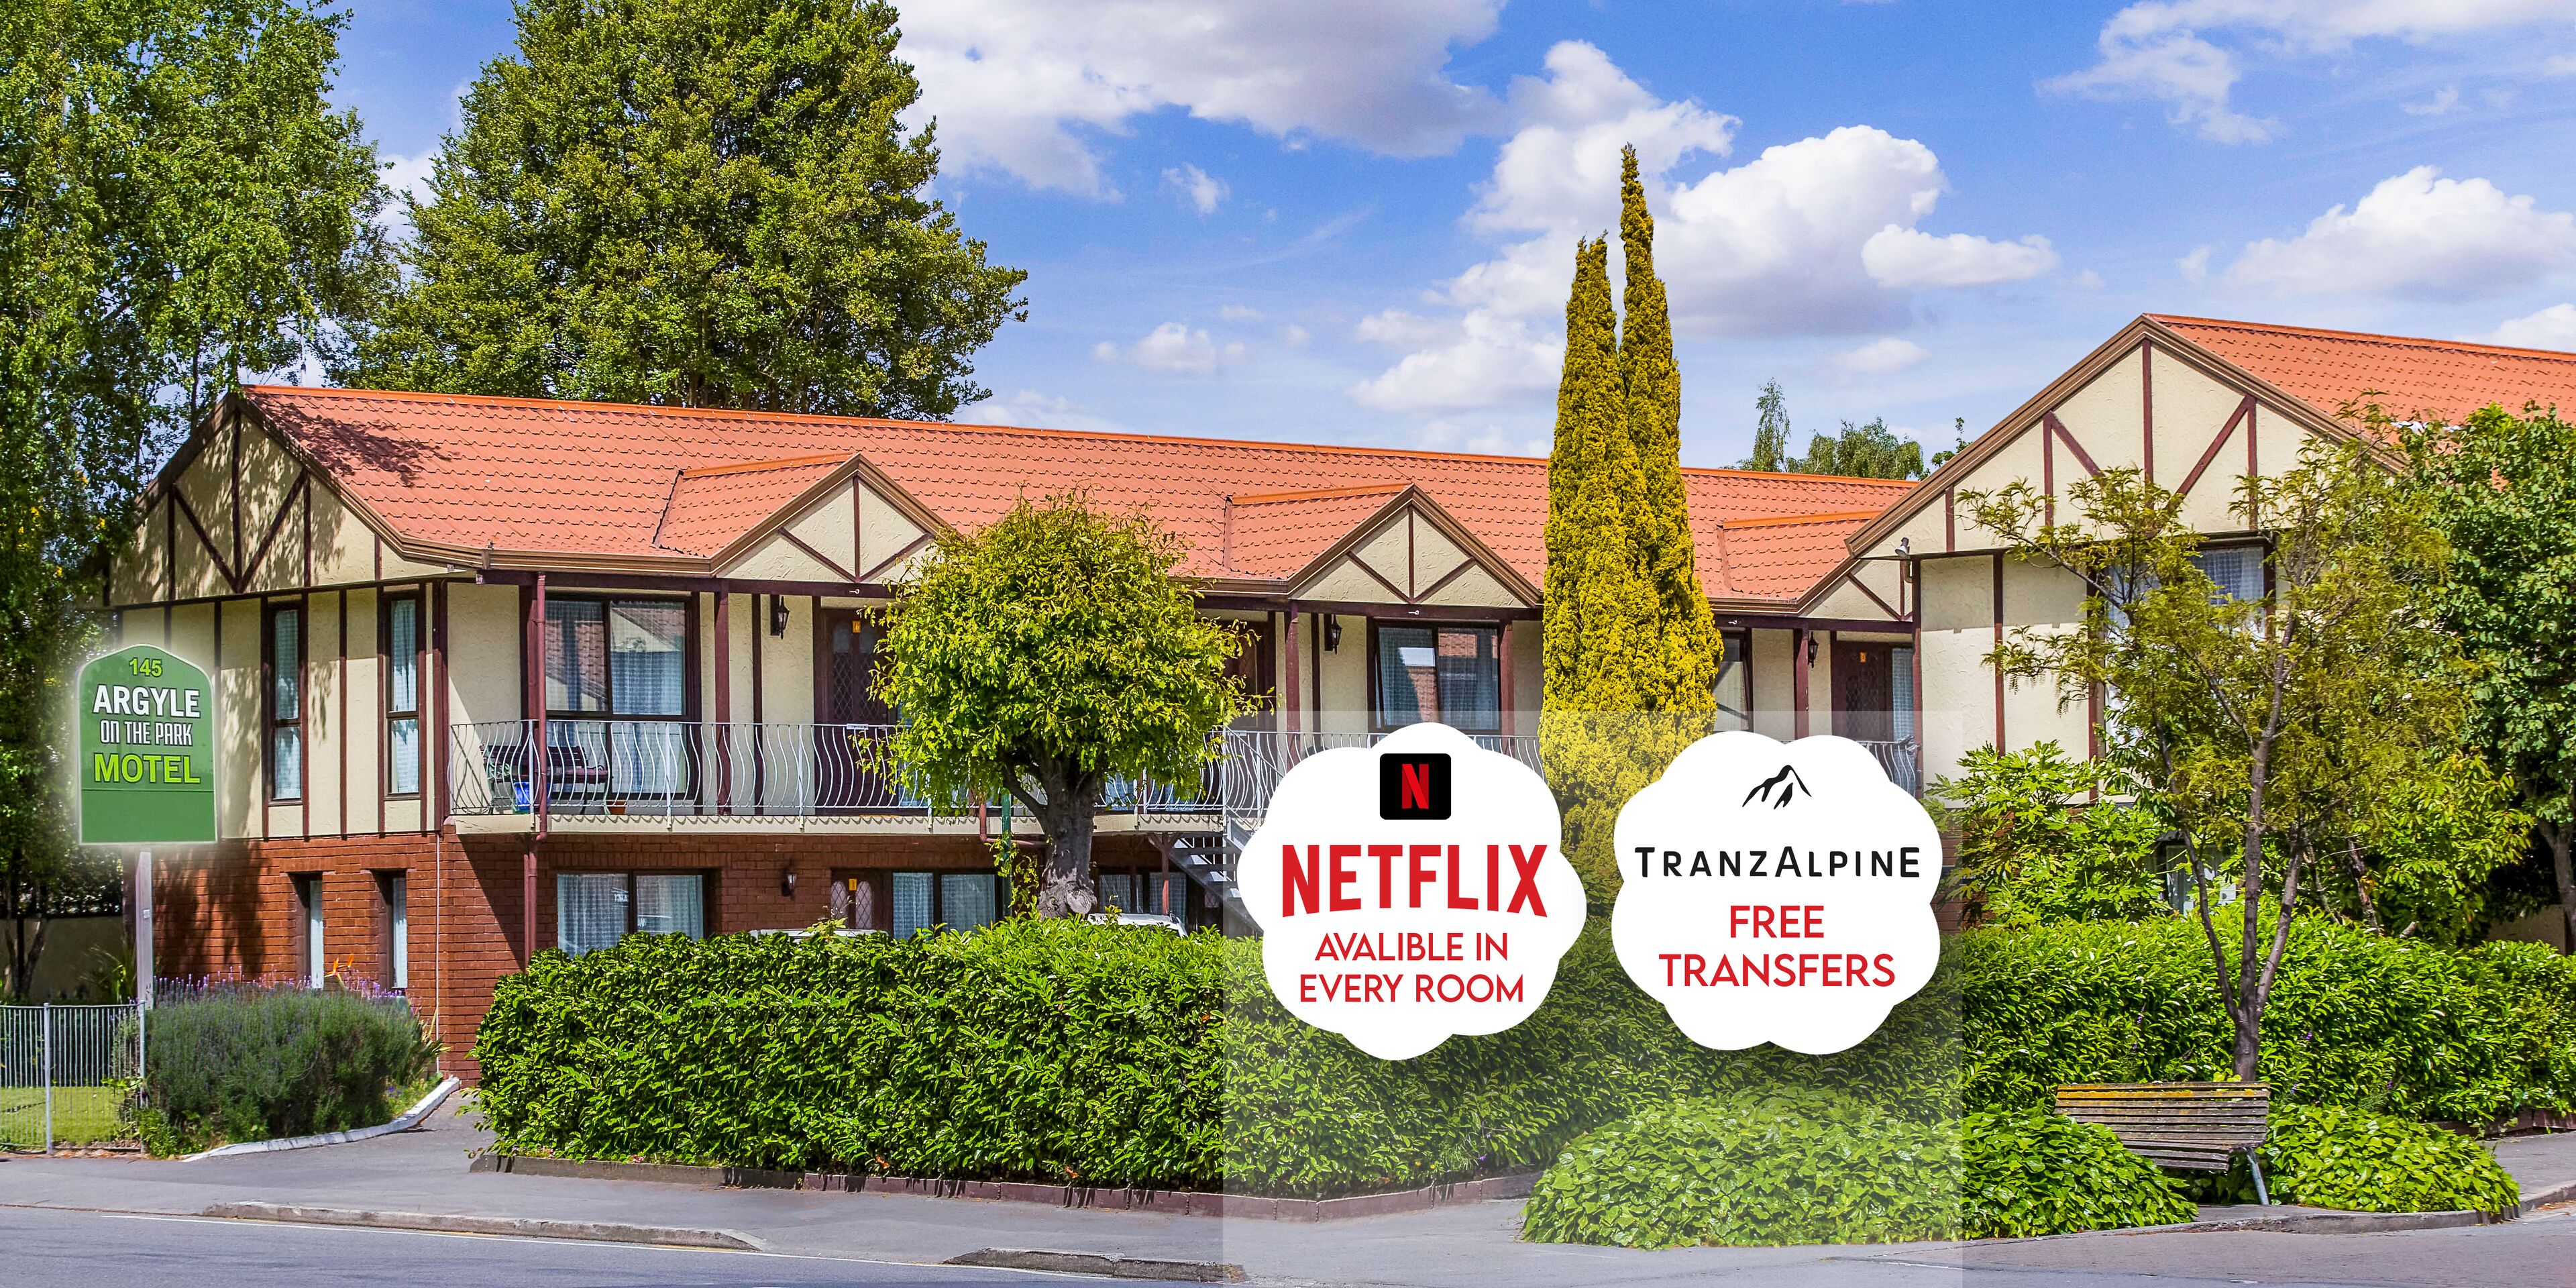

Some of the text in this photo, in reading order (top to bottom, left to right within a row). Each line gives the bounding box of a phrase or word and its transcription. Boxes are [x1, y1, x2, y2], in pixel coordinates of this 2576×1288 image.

[130, 657, 162, 677] 145
[93, 684, 201, 718] ARGYLE
[101, 720, 193, 746] ON THE PARK
[94, 753, 201, 784] MOTEL
